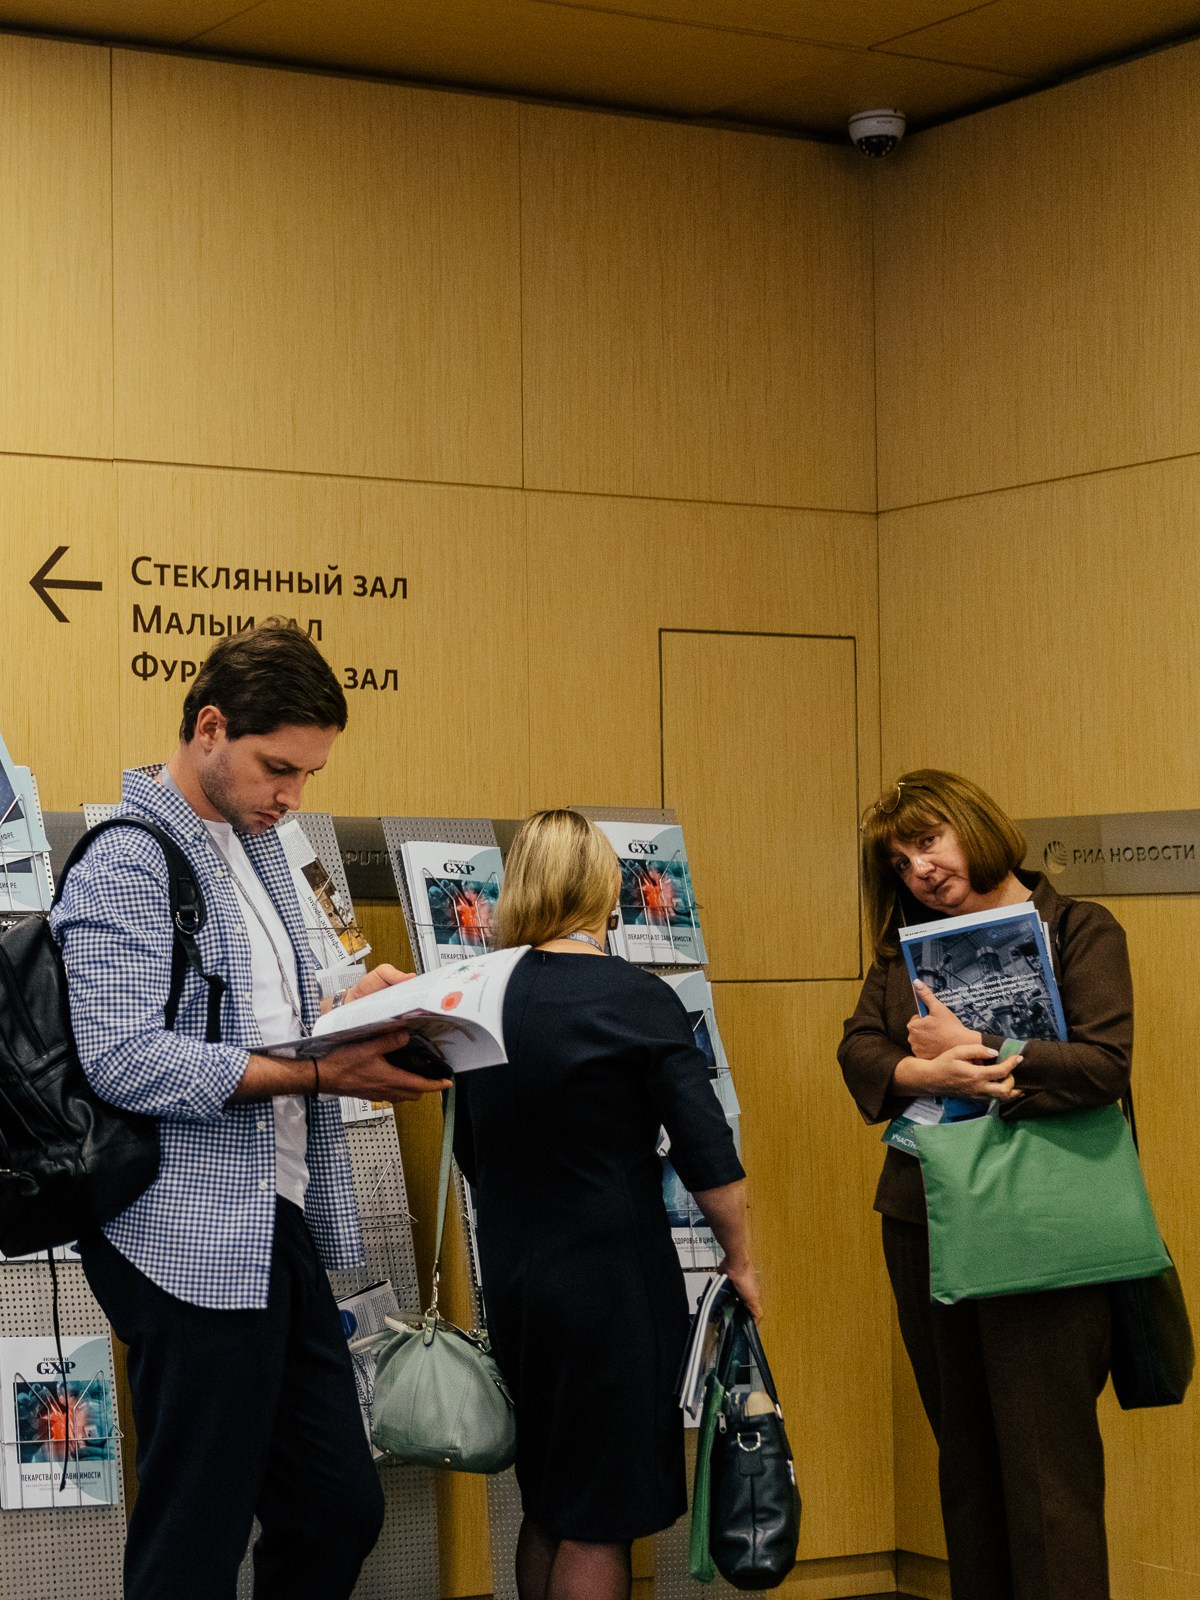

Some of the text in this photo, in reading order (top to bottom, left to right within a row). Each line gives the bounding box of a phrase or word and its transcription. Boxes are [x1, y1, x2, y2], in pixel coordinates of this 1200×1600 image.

[628, 842, 659, 855] GXP
[1072, 844, 1196, 865] РИА НОВОСТИ
[443, 862, 475, 876] GXP
[36, 1361, 76, 1375] GXP
[62, 1471, 102, 1480] АВИИМОСТИ
